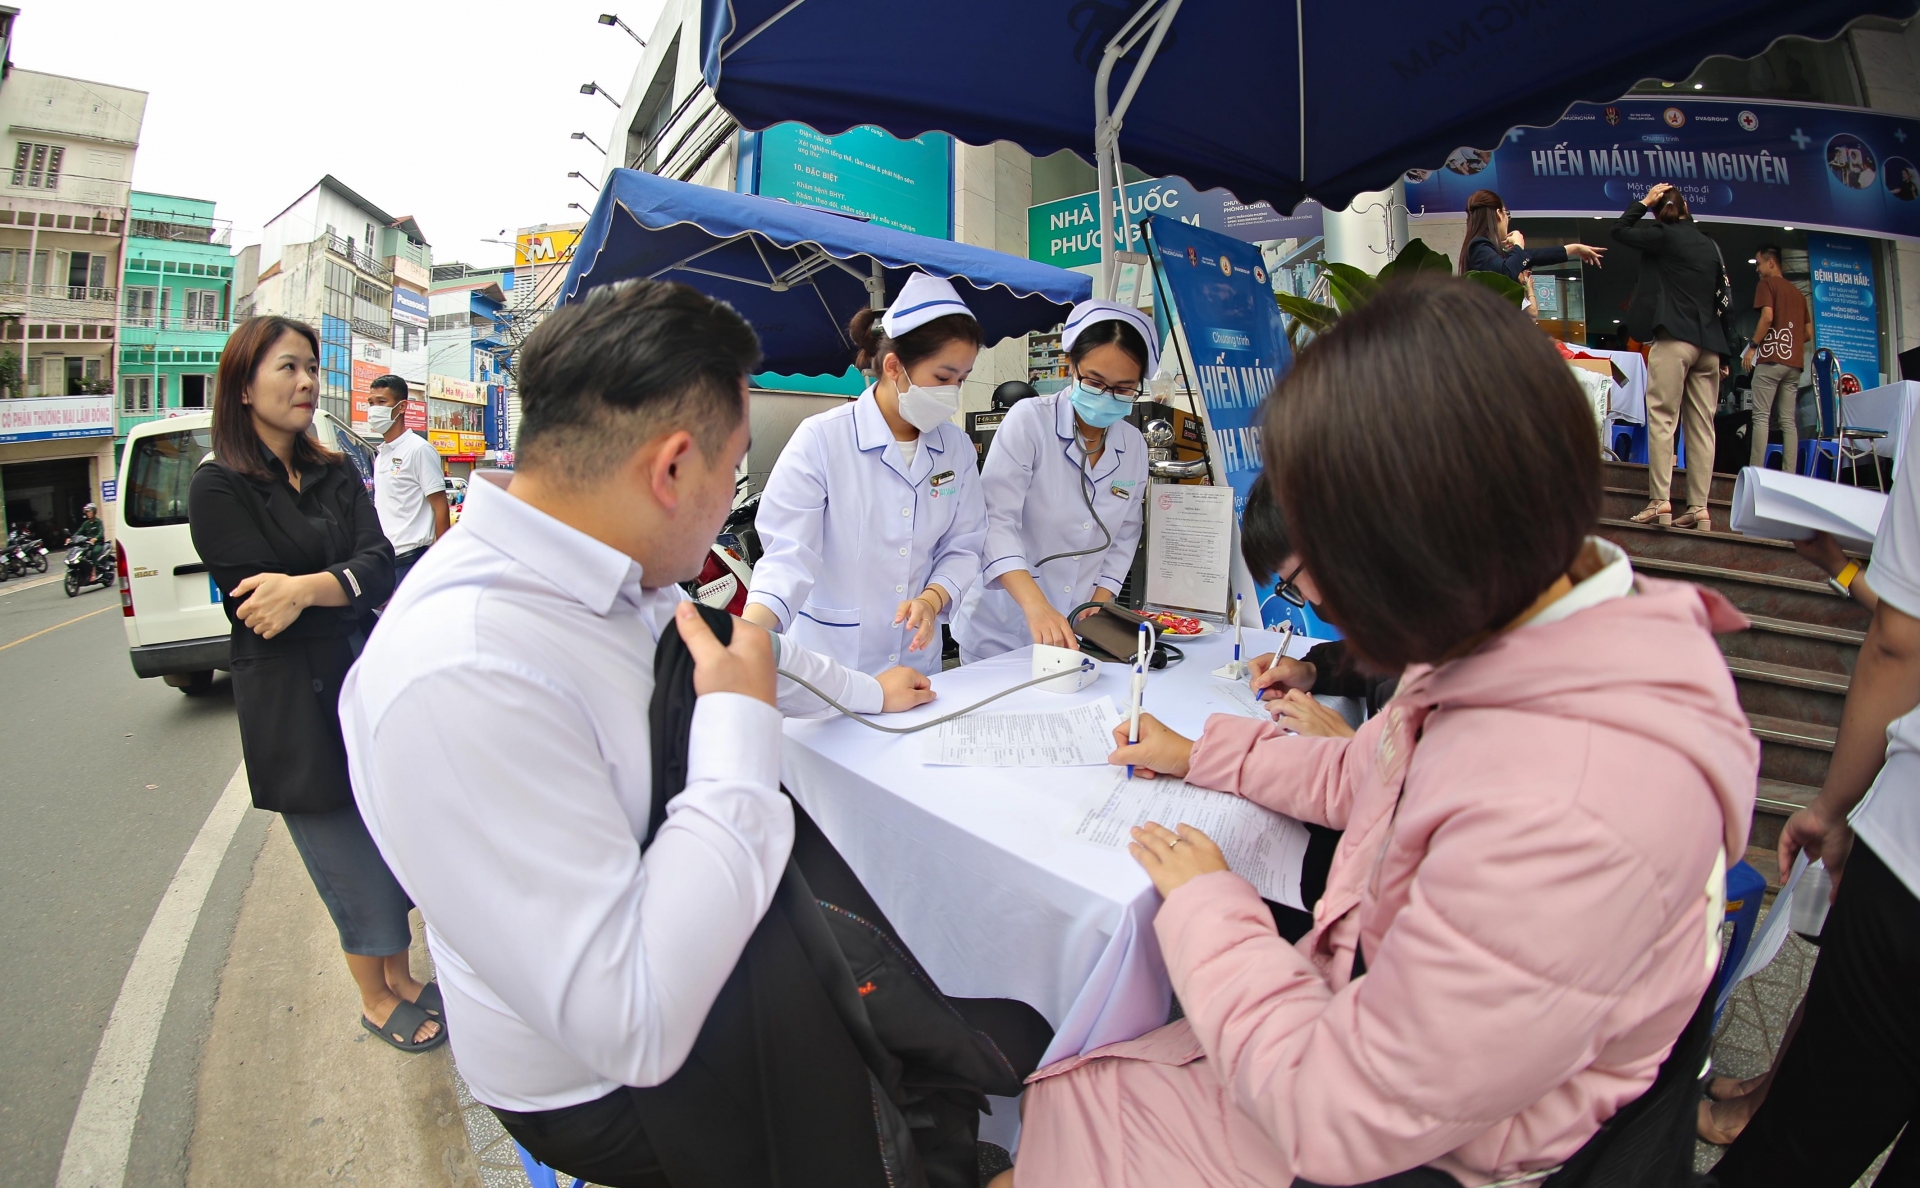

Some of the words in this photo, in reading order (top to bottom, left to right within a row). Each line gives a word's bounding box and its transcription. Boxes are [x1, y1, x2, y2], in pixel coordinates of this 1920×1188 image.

[810, 144, 830, 154] nghiệm
[1531, 142, 1584, 176] HIẾN
[1589, 144, 1640, 177] MÁU
[1644, 144, 1697, 179] TÌNH
[794, 163, 804, 172] 10.
[806, 166, 820, 176] ĐẶC
[822, 172, 838, 182] BIỆT
[796, 181, 812, 190] Khám
[814, 186, 828, 195] bệnh
[830, 190, 846, 200] BHYT.
[1627, 182, 1644, 193] Một
[1684, 185, 1700, 193] cho
[816, 197, 828, 206] theo
[1050, 202, 1095, 231] NHÀ
[1099, 185, 1179, 218] HUỐC
[1224, 205, 1244, 213] PHÒNG
[1814, 269, 1832, 283] BỆNH
[1834, 272, 1852, 285] BẠCH
[397, 294, 428, 312] Panasonic
[1200, 352, 1242, 410] HIẾN
[446, 387, 454, 396] Ha
[455, 388, 464, 400] My
[1184, 419, 1196, 430] NEW
[216, 588, 221, 602] 1
